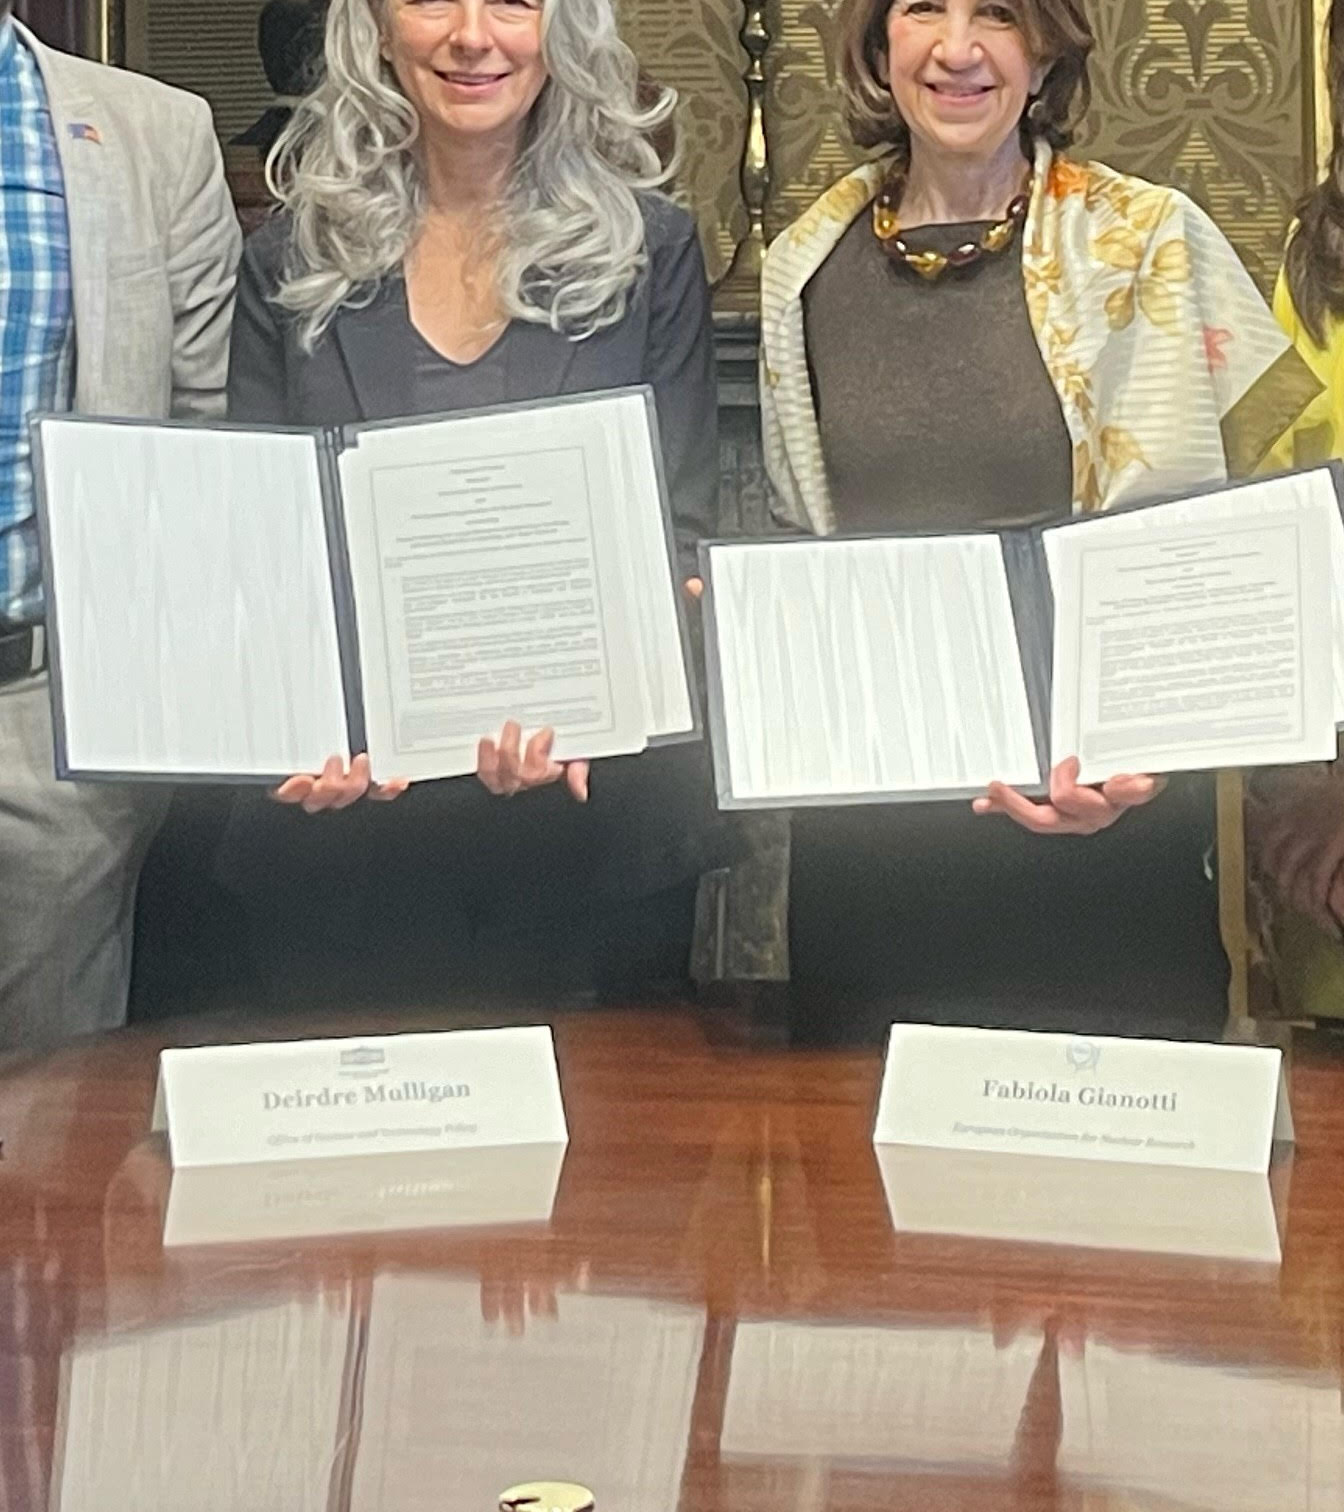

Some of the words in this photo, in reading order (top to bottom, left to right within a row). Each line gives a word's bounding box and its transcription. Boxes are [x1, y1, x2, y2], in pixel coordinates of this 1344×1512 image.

[263, 1087, 358, 1110] Deirdre
[363, 1081, 471, 1103] Mulligan
[982, 1079, 1071, 1103] Fabiola
[1078, 1086, 1178, 1112] Gianotti
